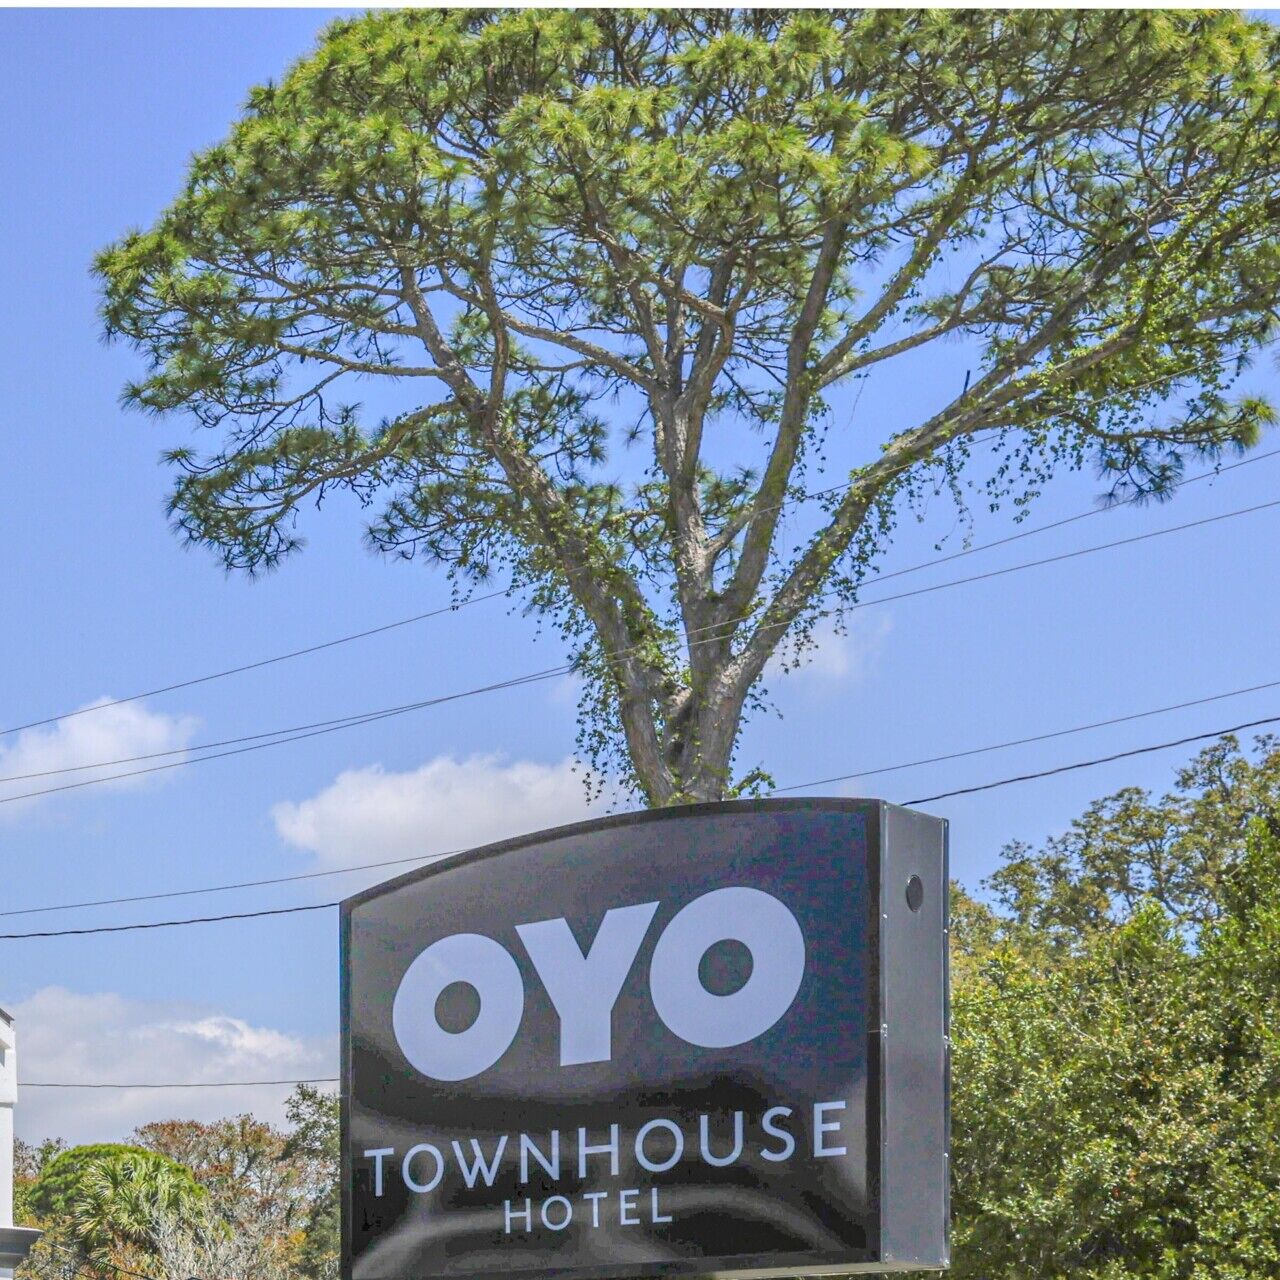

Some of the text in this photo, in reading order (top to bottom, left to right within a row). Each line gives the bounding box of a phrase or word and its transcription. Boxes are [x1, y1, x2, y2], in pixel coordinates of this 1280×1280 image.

[393, 887, 805, 1081] OYO
[364, 1101, 847, 1196] TOWNHOUSE
[504, 1187, 672, 1234] HOTEL
